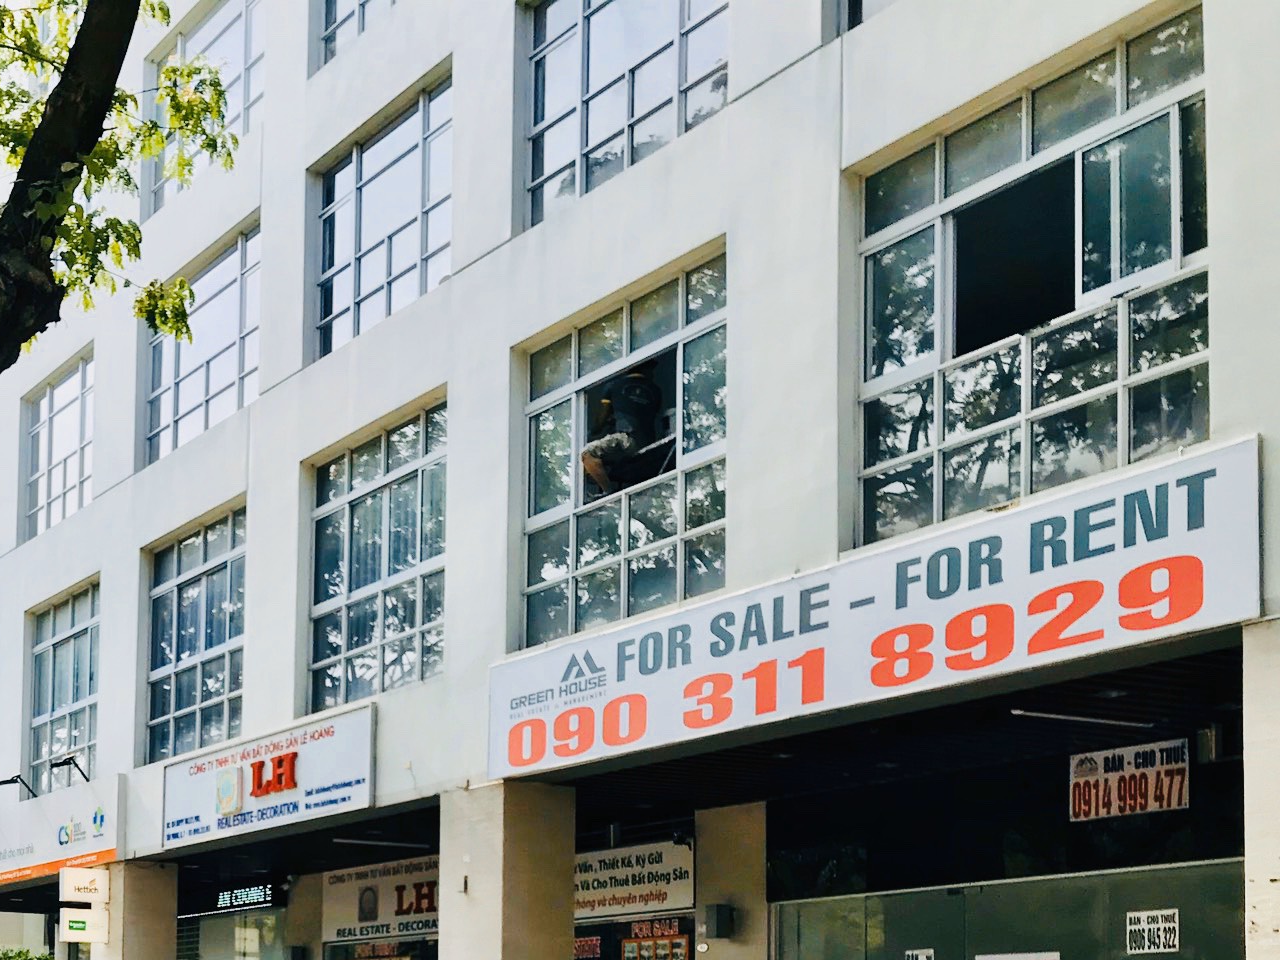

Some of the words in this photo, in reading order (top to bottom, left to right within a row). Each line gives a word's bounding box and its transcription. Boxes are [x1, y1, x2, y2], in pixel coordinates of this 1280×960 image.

[617, 623, 692, 682] FOR
[710, 583, 830, 659] SALE
[896, 536, 1004, 610] FOR
[1029, 468, 1217, 574] RENT
[508, 693, 647, 767] 090
[683, 647, 825, 729] 311
[870, 554, 1204, 687] 8929
[510, 688, 555, 710] GREEN
[559, 674, 607, 698] HOUSE
[250, 751, 298, 797] LH
[1134, 749, 1156, 770] CHO
[1072, 778, 1112, 819] 0914
[1117, 772, 1149, 814] 999
[1154, 767, 1186, 809] 477
[395, 881, 437, 916] LH
[592, 878, 608, 890] Cho
[336, 927, 358, 938] REAL
[360, 924, 391, 936] ESTATE
[398, 919, 439, 933] DECORA
